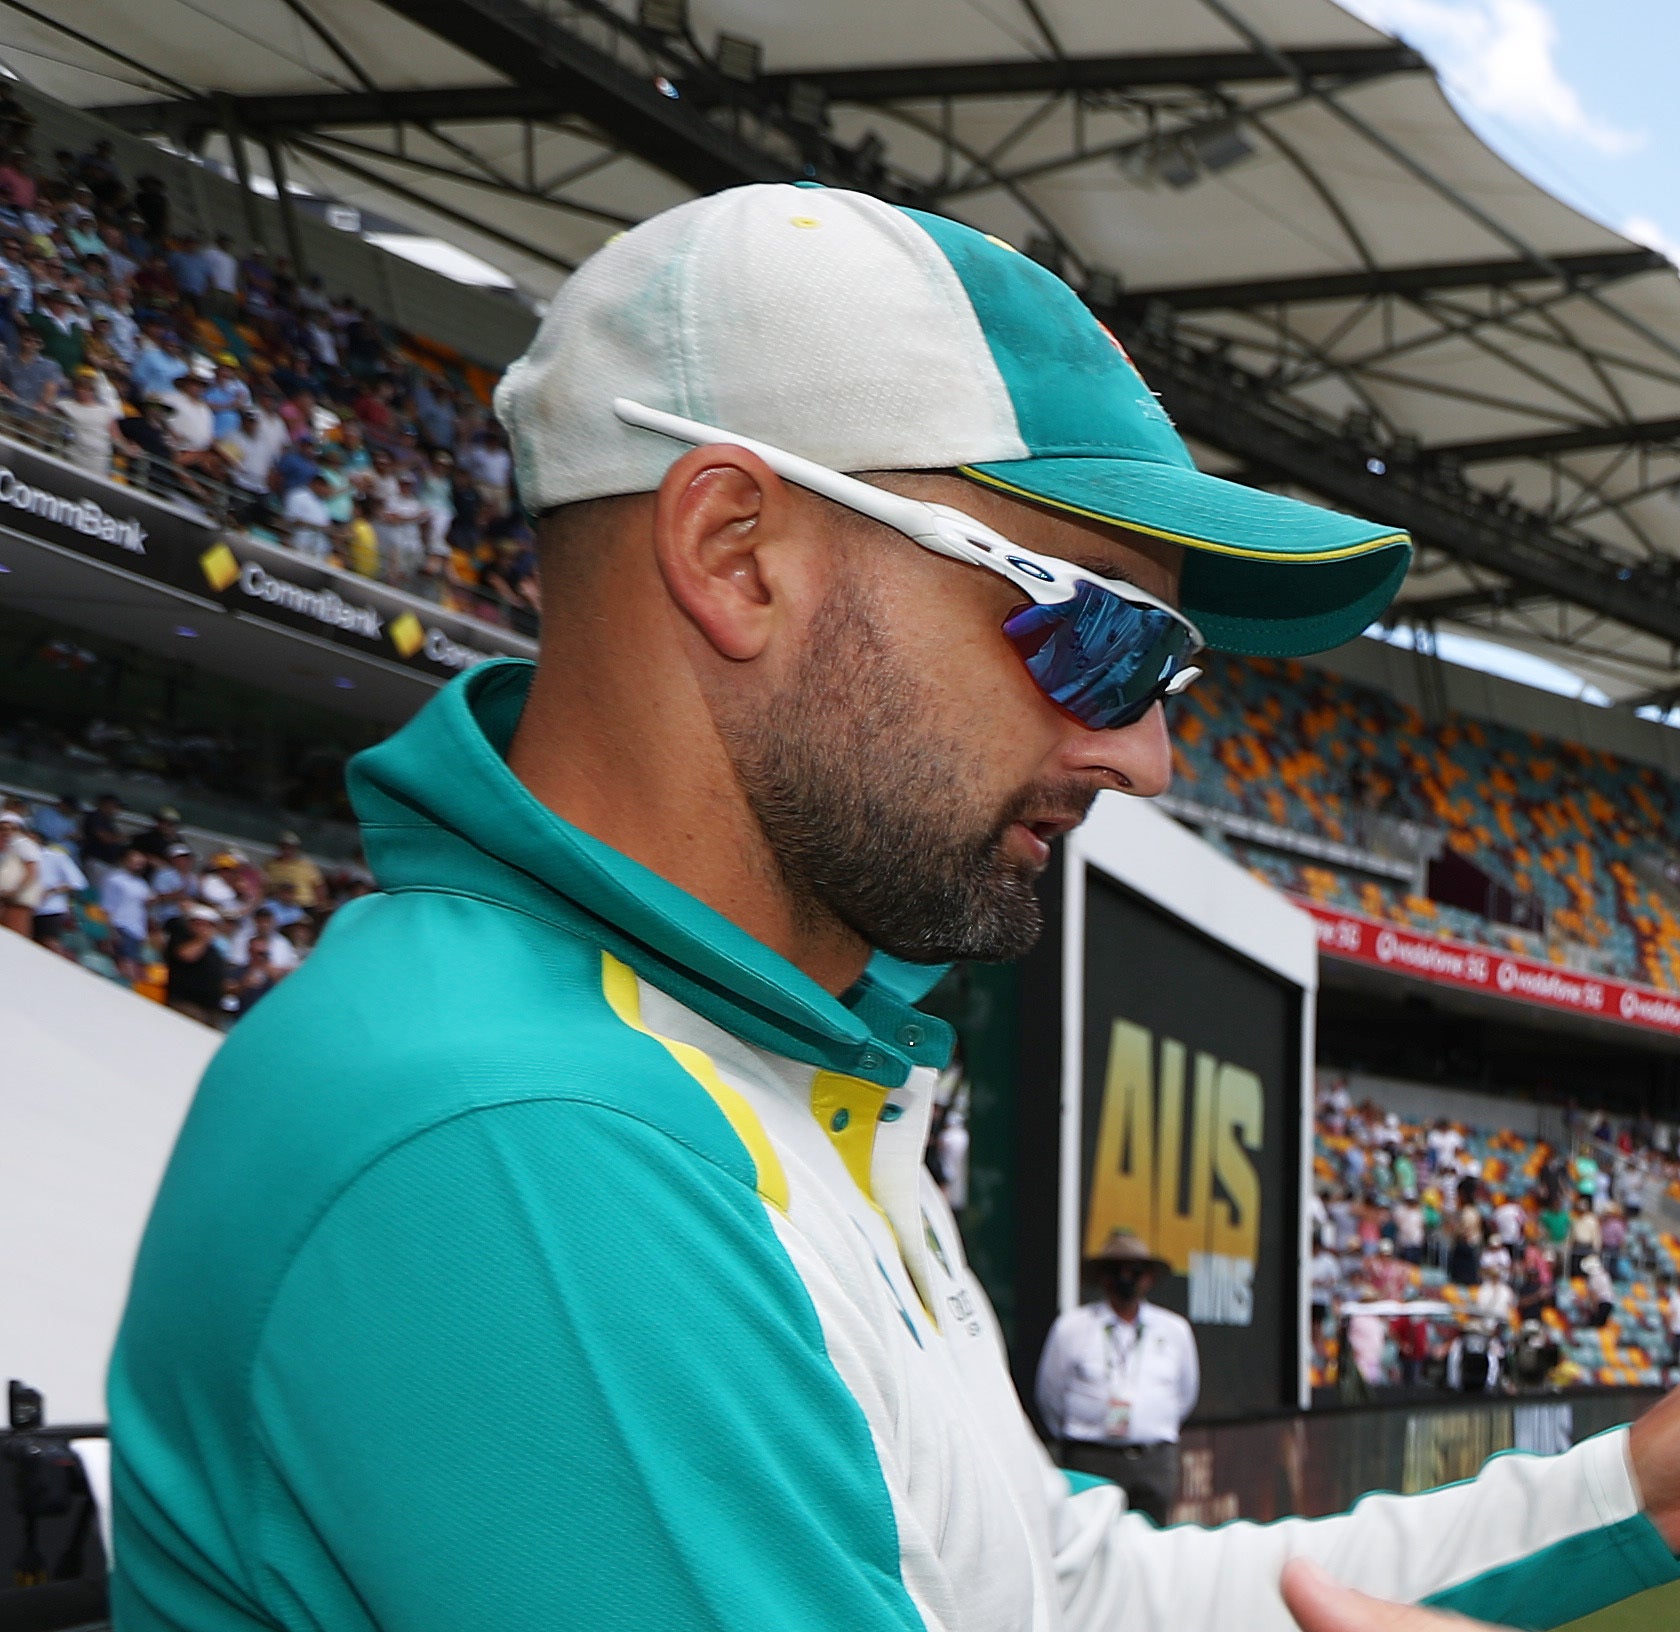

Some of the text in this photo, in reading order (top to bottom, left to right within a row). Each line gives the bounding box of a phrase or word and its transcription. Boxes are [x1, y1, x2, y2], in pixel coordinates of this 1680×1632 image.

[0, 465, 148, 554] CommBank
[239, 560, 383, 640] CommBank
[1401, 941, 1463, 977] vodafone
[1083, 1016, 1265, 1278] AUS
